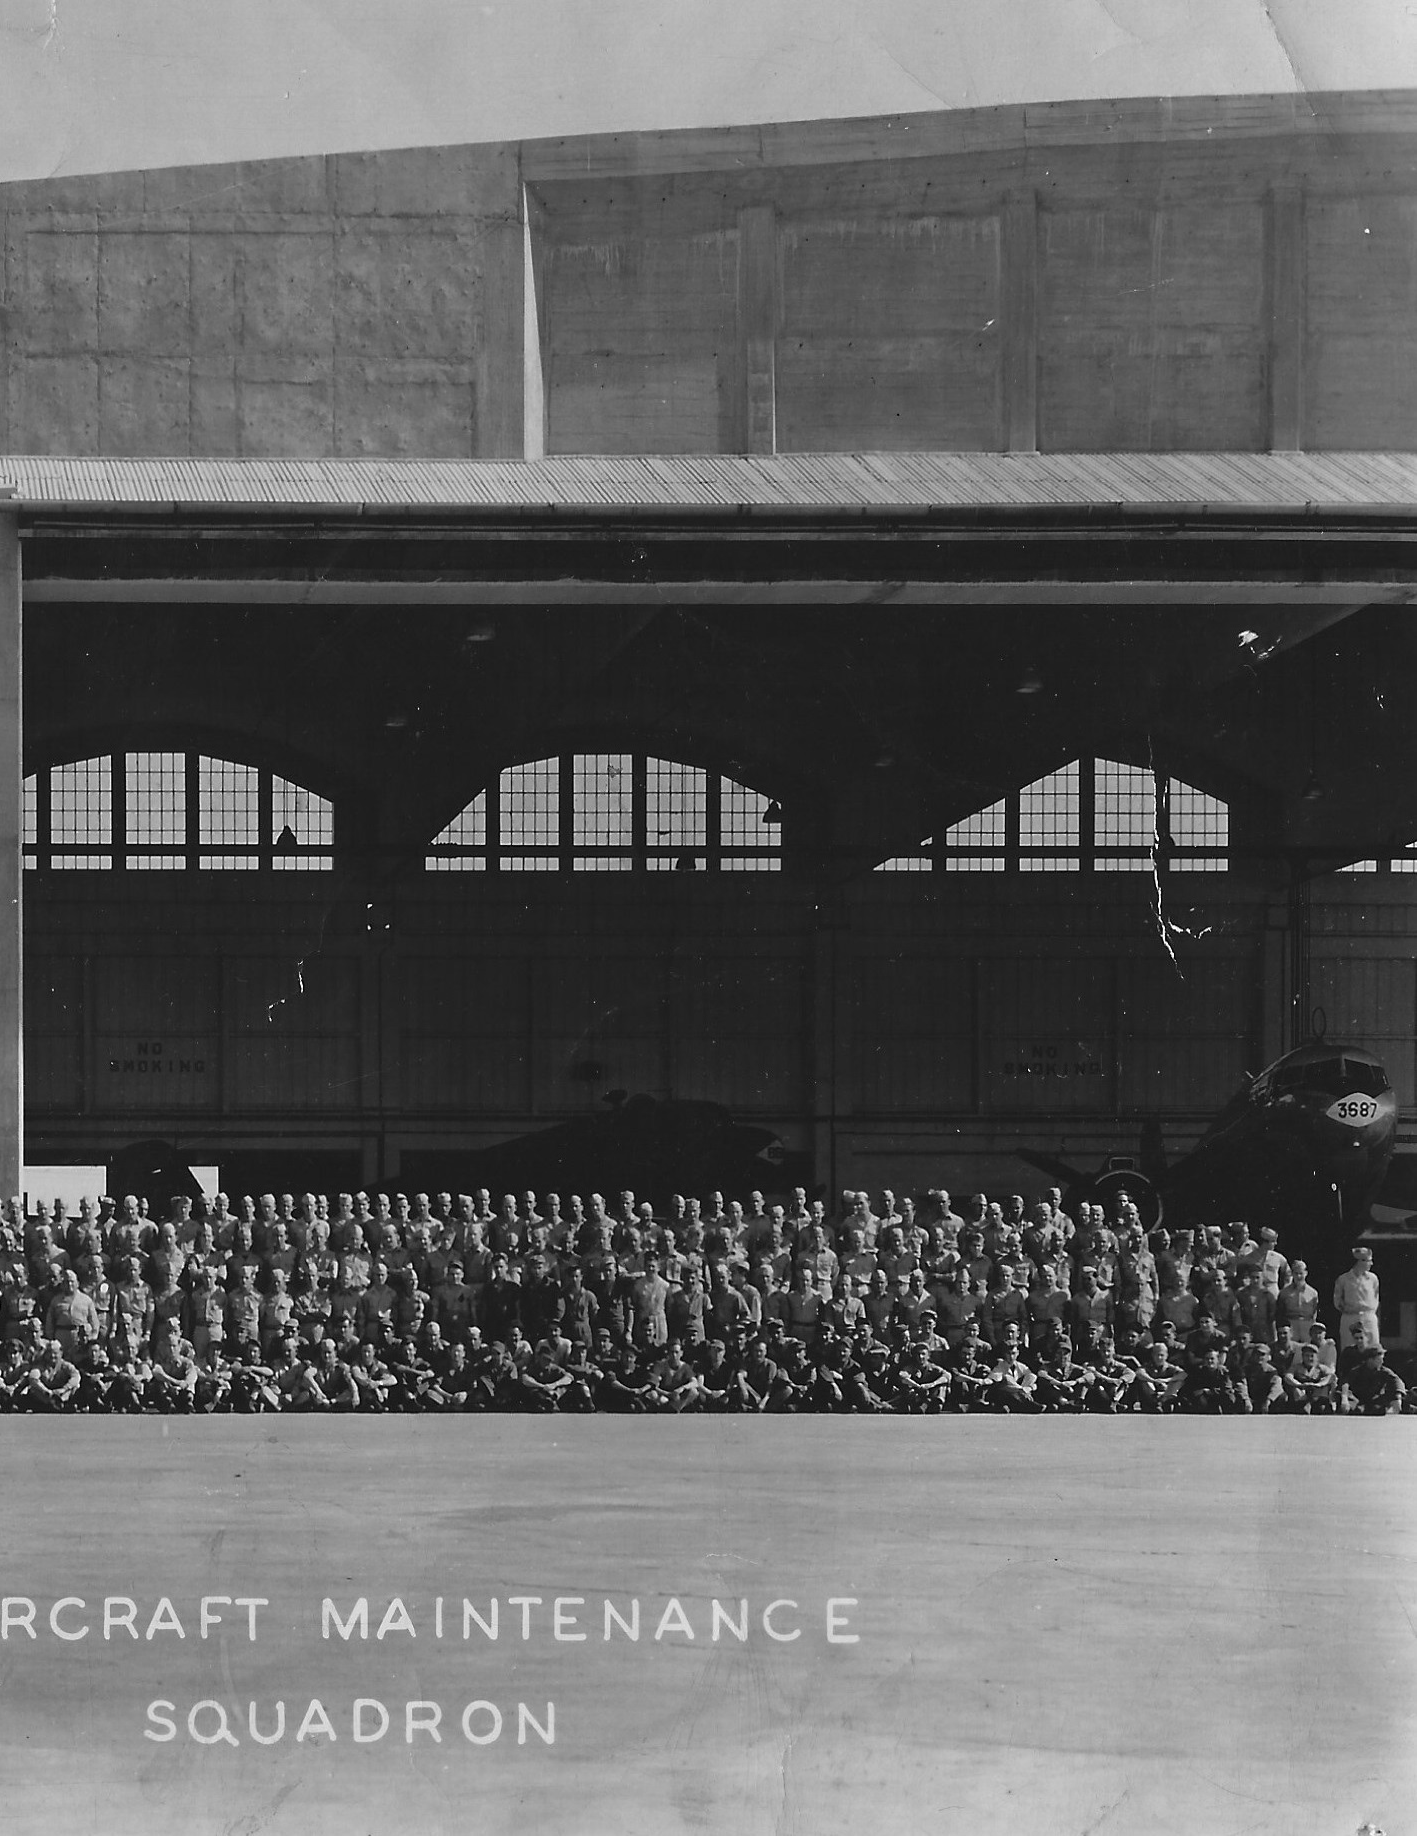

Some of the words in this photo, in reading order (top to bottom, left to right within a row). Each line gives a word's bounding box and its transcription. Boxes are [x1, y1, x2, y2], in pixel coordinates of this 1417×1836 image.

[138, 1042, 162, 1055] NO
[1032, 1045, 1057, 1058] NO
[109, 1060, 204, 1073] SMOKING
[1337, 1101, 1377, 1118] 3687
